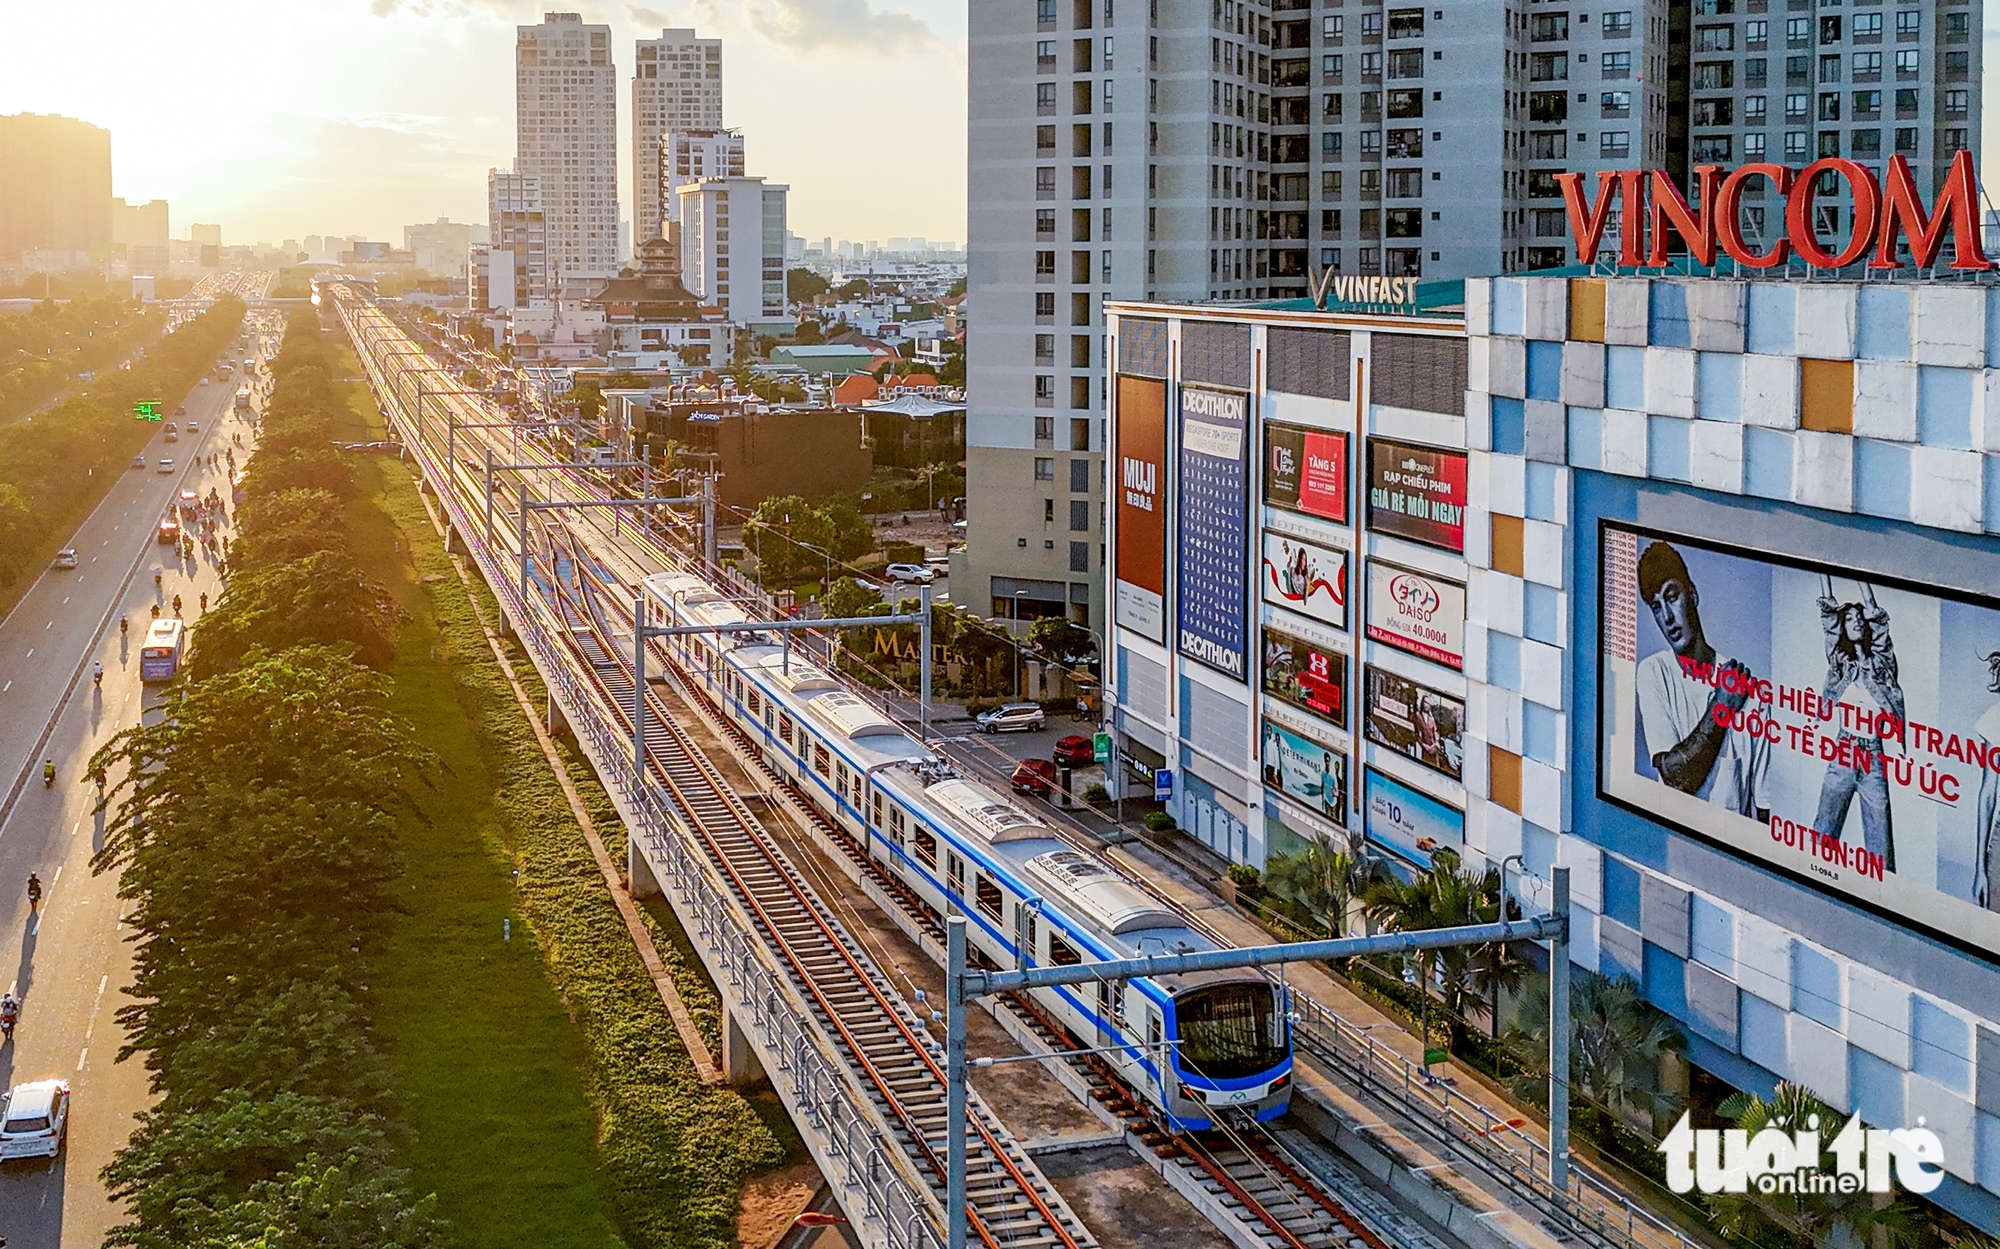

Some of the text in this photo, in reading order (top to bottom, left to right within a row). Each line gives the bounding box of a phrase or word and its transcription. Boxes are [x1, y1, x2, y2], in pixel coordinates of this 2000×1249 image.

[1552, 150, 1999, 270] VINCOM
[1334, 276, 1418, 304] VINFAST
[1183, 391, 1242, 420] DECATHLON
[1124, 456, 1156, 494] MUJI
[1330, 461, 1336, 472] 5
[1384, 471, 1451, 494] RẠP CHIẾU PHIM
[1371, 488, 1462, 526] GIÁ RẺ MỖI NGÀY
[1399, 602, 1432, 623] DAISO
[1412, 624, 1446, 645] 40.000đ
[1181, 629, 1240, 674] DECATHLON
[1678, 655, 1773, 705] THƯƠNG
[1780, 685, 1833, 722] HIỆU
[1839, 702, 1903, 743] THỜI
[1712, 703, 1960, 802] QUỐC TẾ ĐẾN TỪ ÚC
[1388, 802, 1401, 824] 10
